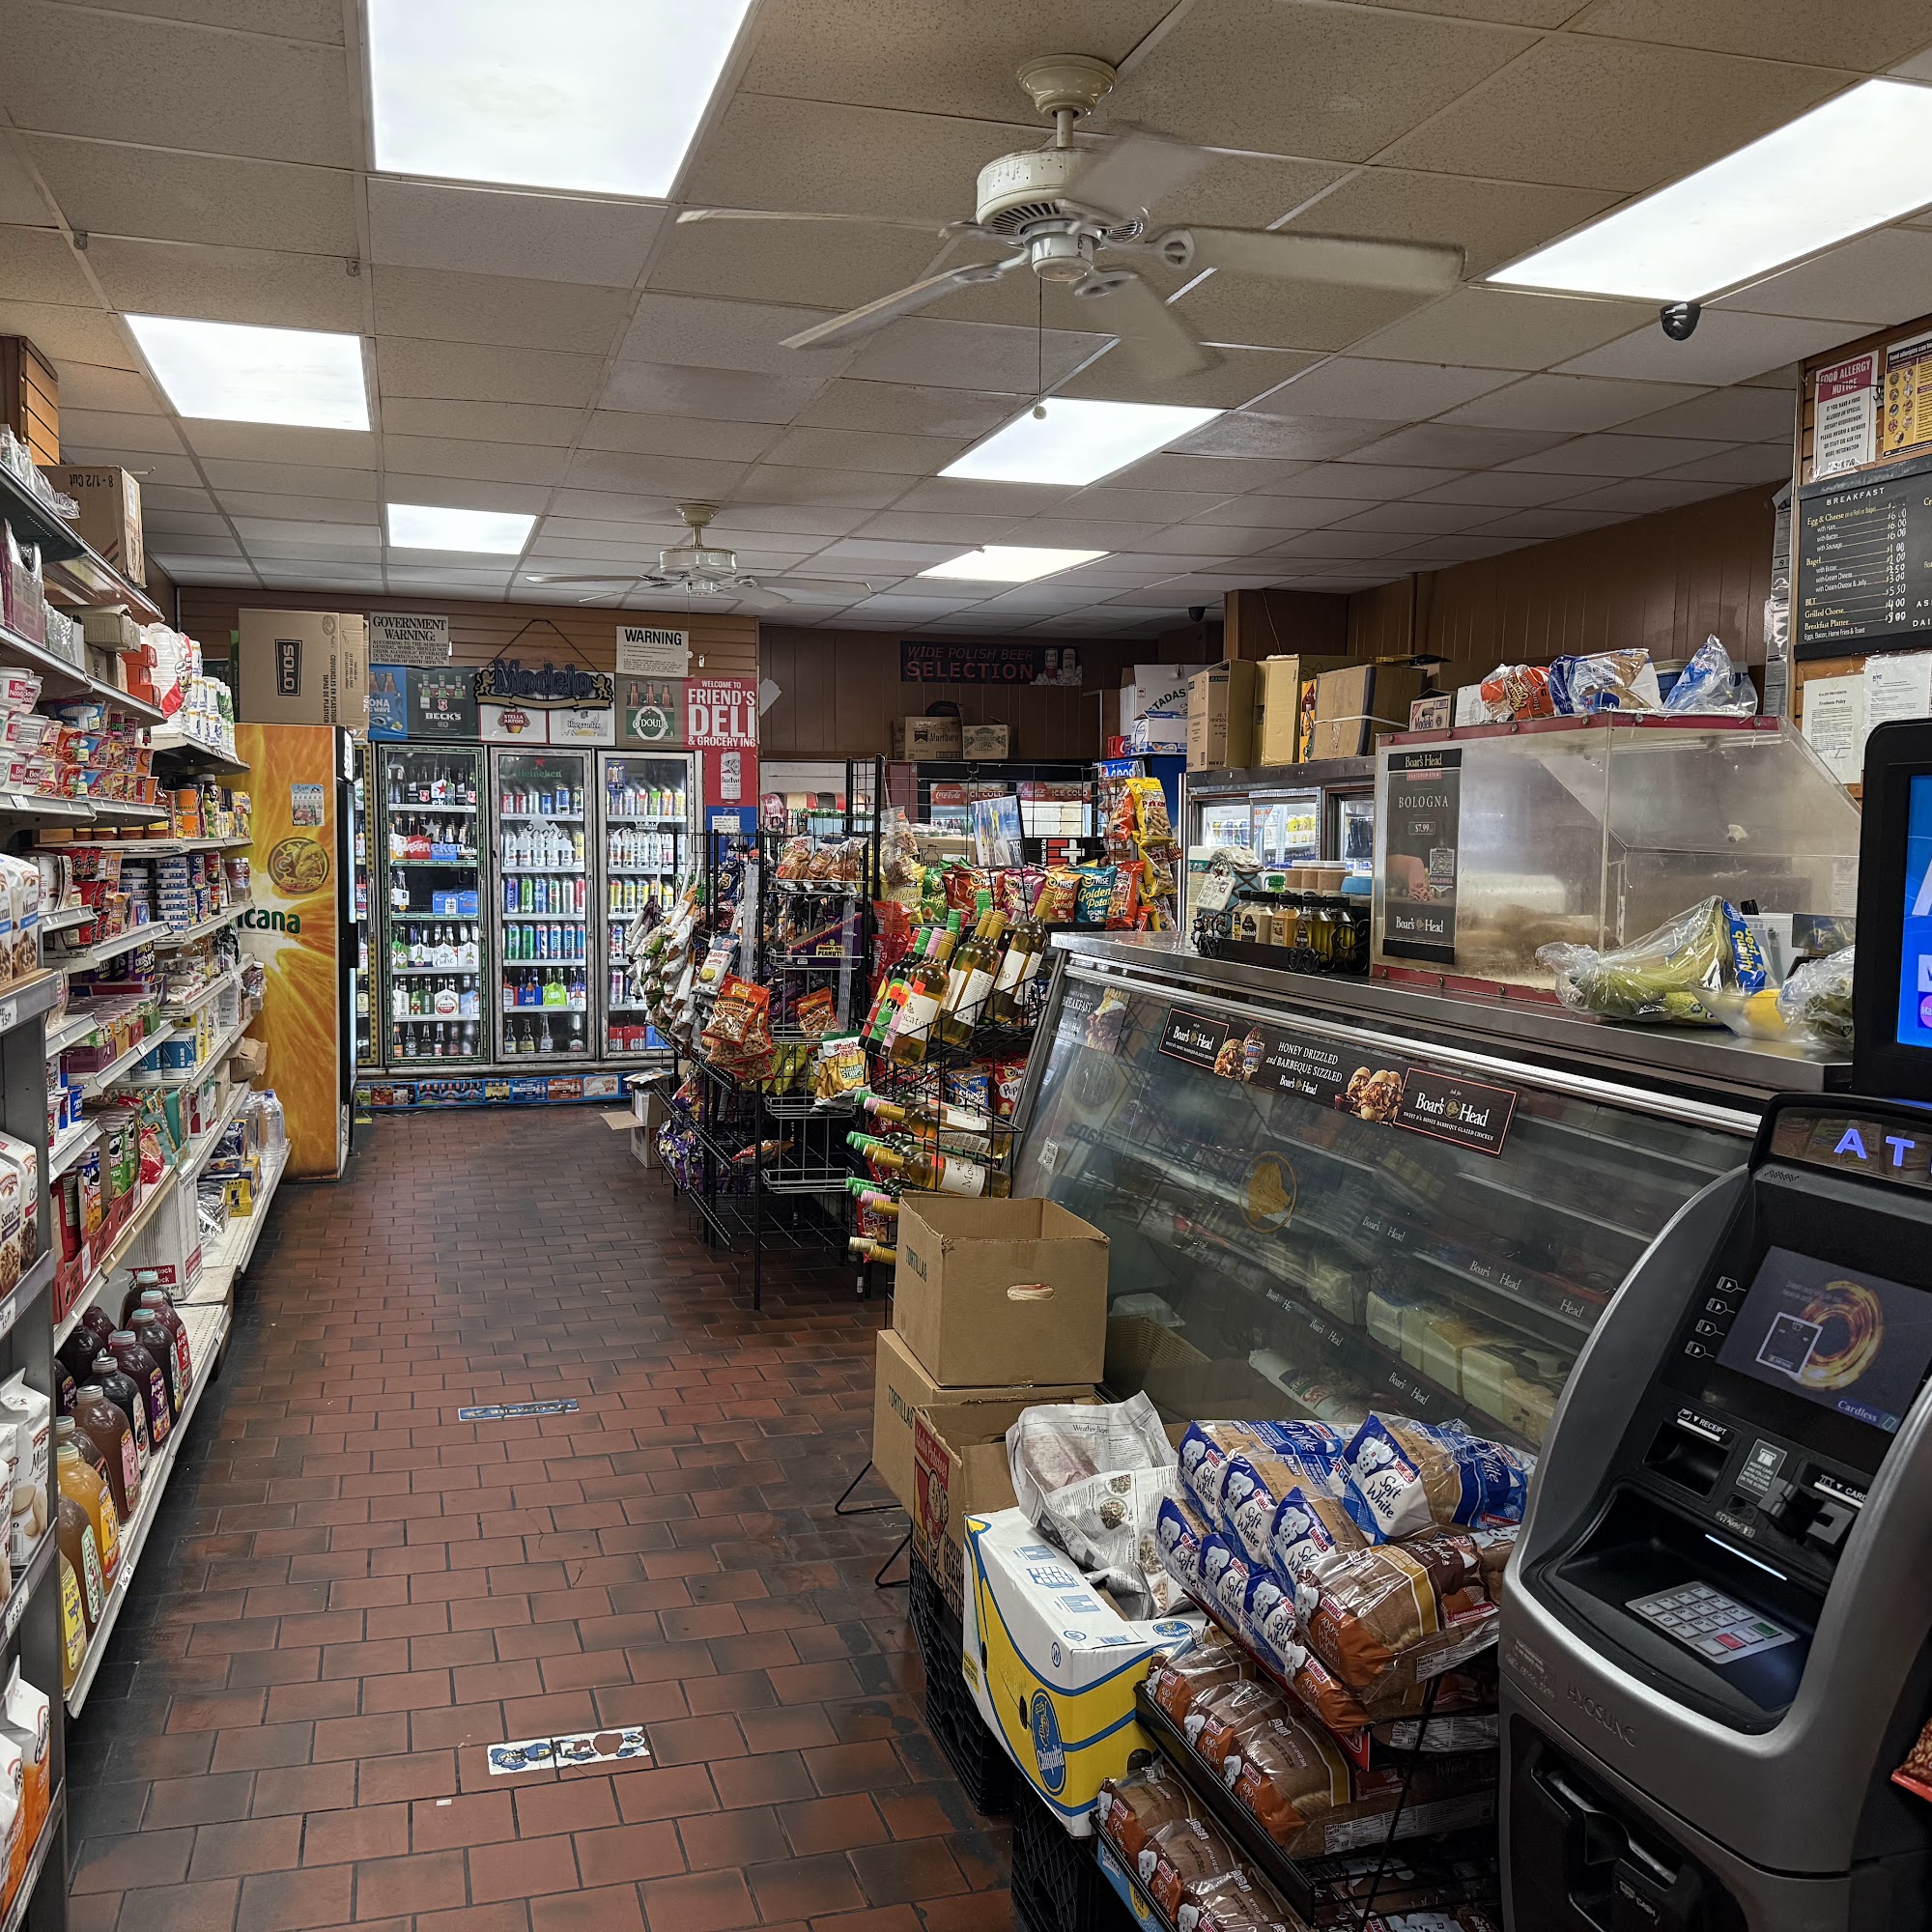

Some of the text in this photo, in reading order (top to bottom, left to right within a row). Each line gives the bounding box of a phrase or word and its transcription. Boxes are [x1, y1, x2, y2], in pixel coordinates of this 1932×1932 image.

[1821, 359, 1871, 384] FOOD ALLERGY
[1832, 378, 1858, 395] NOTICE
[69, 474, 100, 487] 1/2 Cut
[1826, 487, 1885, 506] BREAKFAST
[1806, 513, 1844, 527] Egg Cheese
[1826, 542, 1843, 551] Sausage
[1806, 556, 1822, 567] Bagel
[373, 616, 446, 630] GOVERNMENT
[1804, 610, 1824, 618] Grilled
[1804, 619, 1849, 630] Breakfast Platter
[384, 629, 436, 641] WARNING:
[625, 629, 682, 645] WARNING
[907, 645, 1034, 661] WIDE POLISH BEER
[283, 644, 295, 690] SOLO
[907, 661, 1034, 680] SELECTION
[495, 659, 592, 696] Modelo
[701, 680, 731, 689] WELCOME
[688, 688, 755, 705] FRIEND'S
[688, 704, 755, 738] DELI
[688, 736, 696, 745] &
[697, 736, 739, 747] GROCERY
[1406, 754, 1442, 768] Boar's Head
[1398, 796, 1448, 809] BOLOGNA
[1414, 824, 1430, 833] $7.99
[1078, 888, 1111, 901] Golden
[1396, 917, 1443, 933] Boar's Head
[1173, 1026, 1214, 1050] Boar's Head
[1278, 1041, 1339, 1065] HONEY DRIZZLED
[1266, 1055, 1276, 1065] and
[1277, 1057, 1312, 1074] BARBEQUE
[1280, 1075, 1318, 1095] Boar's Head
[1415, 1093, 1490, 1127] Boar's Head
[1458, 1126, 1474, 1136] GLAZED
[1474, 1130, 1493, 1141] CHICKEN
[1362, 1216, 1405, 1242] Boar's Head
[905, 1245, 927, 1282] TORTILLAS
[1469, 1261, 1520, 1292] Boar's Head
[1560, 1299, 1584, 1318] Head
[1389, 1373, 1430, 1406] Boar's Head
[889, 1384, 914, 1430] TORTILLAS
[1837, 1400, 1877, 1423] Cardless
[1699, 1418, 1727, 1436] RECEIPT
[1201, 1467, 1215, 1486] Soft
[1196, 1480, 1215, 1505] White
[1379, 1475, 1401, 1499] Soft
[1367, 1484, 1394, 1519] White
[1245, 1506, 1262, 1529] Soft
[1237, 1517, 1260, 1548] White
[1310, 1528, 1328, 1552] BIMBO
[1177, 1551, 1195, 1571] Soft
[1227, 1576, 1244, 1597] Soft
[1221, 1589, 1242, 1615] White
[1321, 1599, 1342, 1619] BIMBO
[1453, 1605, 1492, 1619] Bimbousa.com
[1273, 1614, 1294, 1635] Soft
[1321, 1616, 1340, 1637] 100%
[1318, 1626, 1339, 1651] Whole
[1418, 1650, 1444, 1662] Nutrition
[1307, 1661, 1327, 1681] BIMBO
[1304, 1678, 1321, 1698] 100%
[1567, 1681, 1636, 1747] HYOSUNG
[1037, 1745, 1065, 1776] Chiquita
